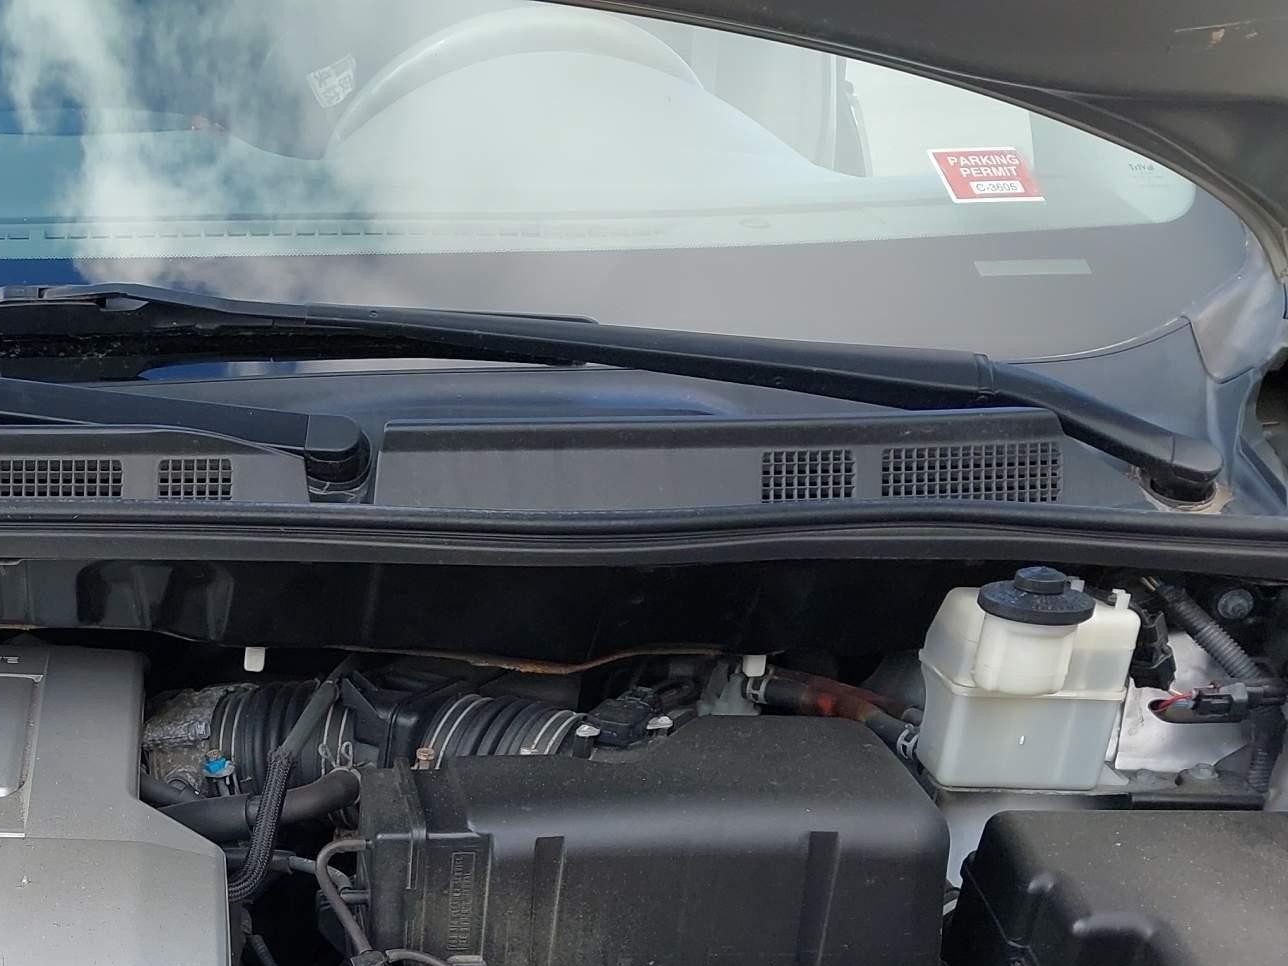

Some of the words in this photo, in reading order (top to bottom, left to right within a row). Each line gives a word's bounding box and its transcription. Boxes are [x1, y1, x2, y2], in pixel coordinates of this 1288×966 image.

[947, 154, 1020, 167] PARKING
[960, 166, 1018, 178] PERMIT
[975, 182, 1018, 192] C-3605
